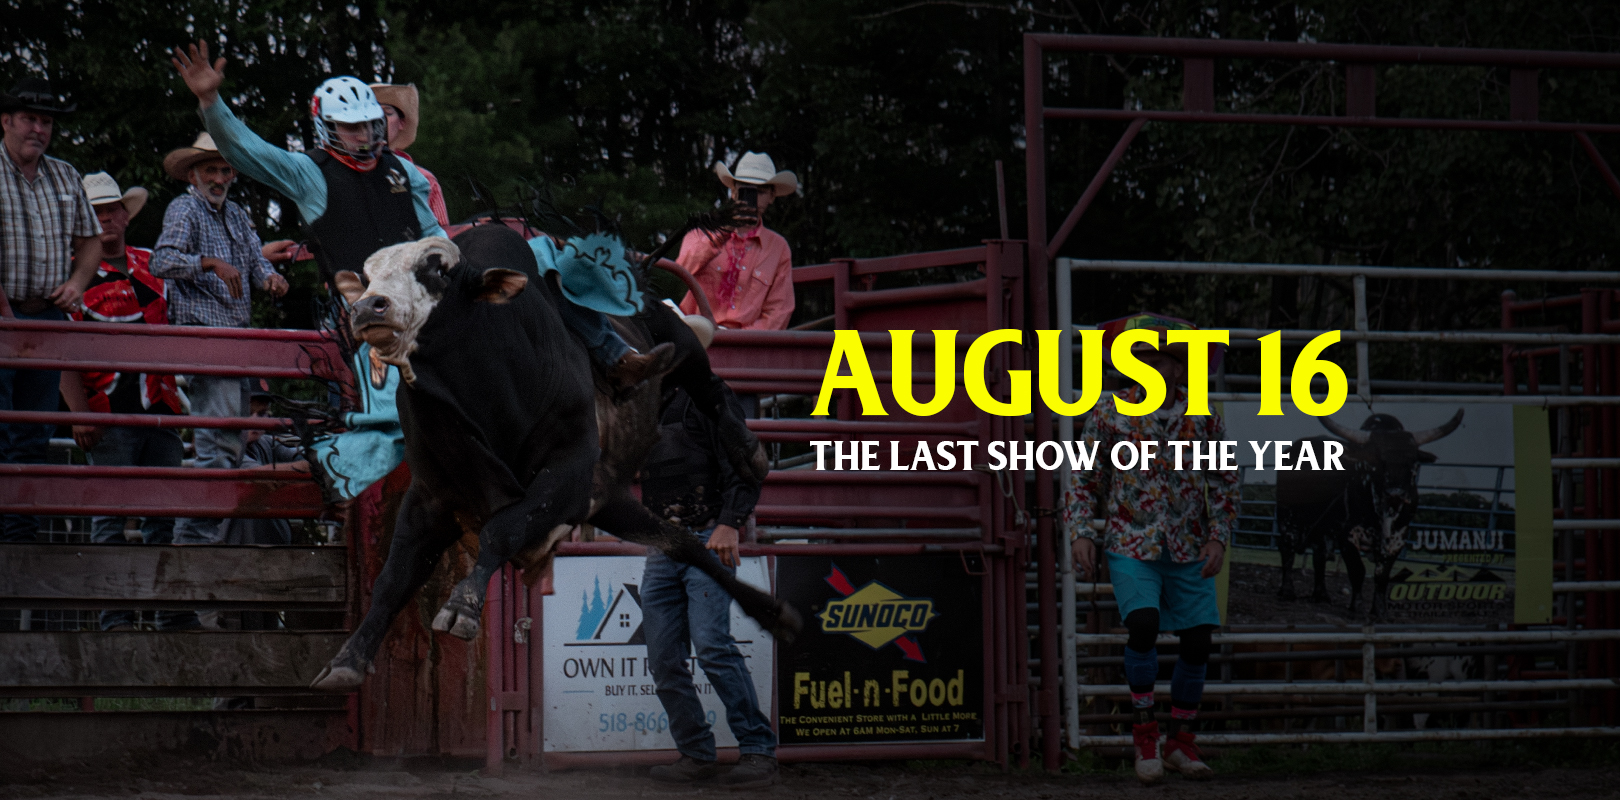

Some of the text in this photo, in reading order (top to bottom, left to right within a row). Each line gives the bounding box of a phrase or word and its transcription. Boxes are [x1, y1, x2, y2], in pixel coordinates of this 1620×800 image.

[1412, 529, 1504, 551] JUMANJI
[1389, 583, 1507, 601] OUTDOOR
[1387, 602, 1443, 611] MOTOR
[826, 604, 928, 628] SUNOCO
[563, 657, 614, 678] OWN
[621, 657, 637, 677] IT
[605, 685, 624, 696] BUY
[780, 712, 977, 725] THE CONVENIENT STORE WITH A LITTLE MORE
[795, 728, 810, 737] WE
[812, 727, 836, 736] OPEN
[839, 727, 851, 736] AT
[853, 726, 873, 735] 6AM
[920, 725, 939, 733] SUN
[941, 725, 952, 733] AT
[954, 724, 960, 733] 7
